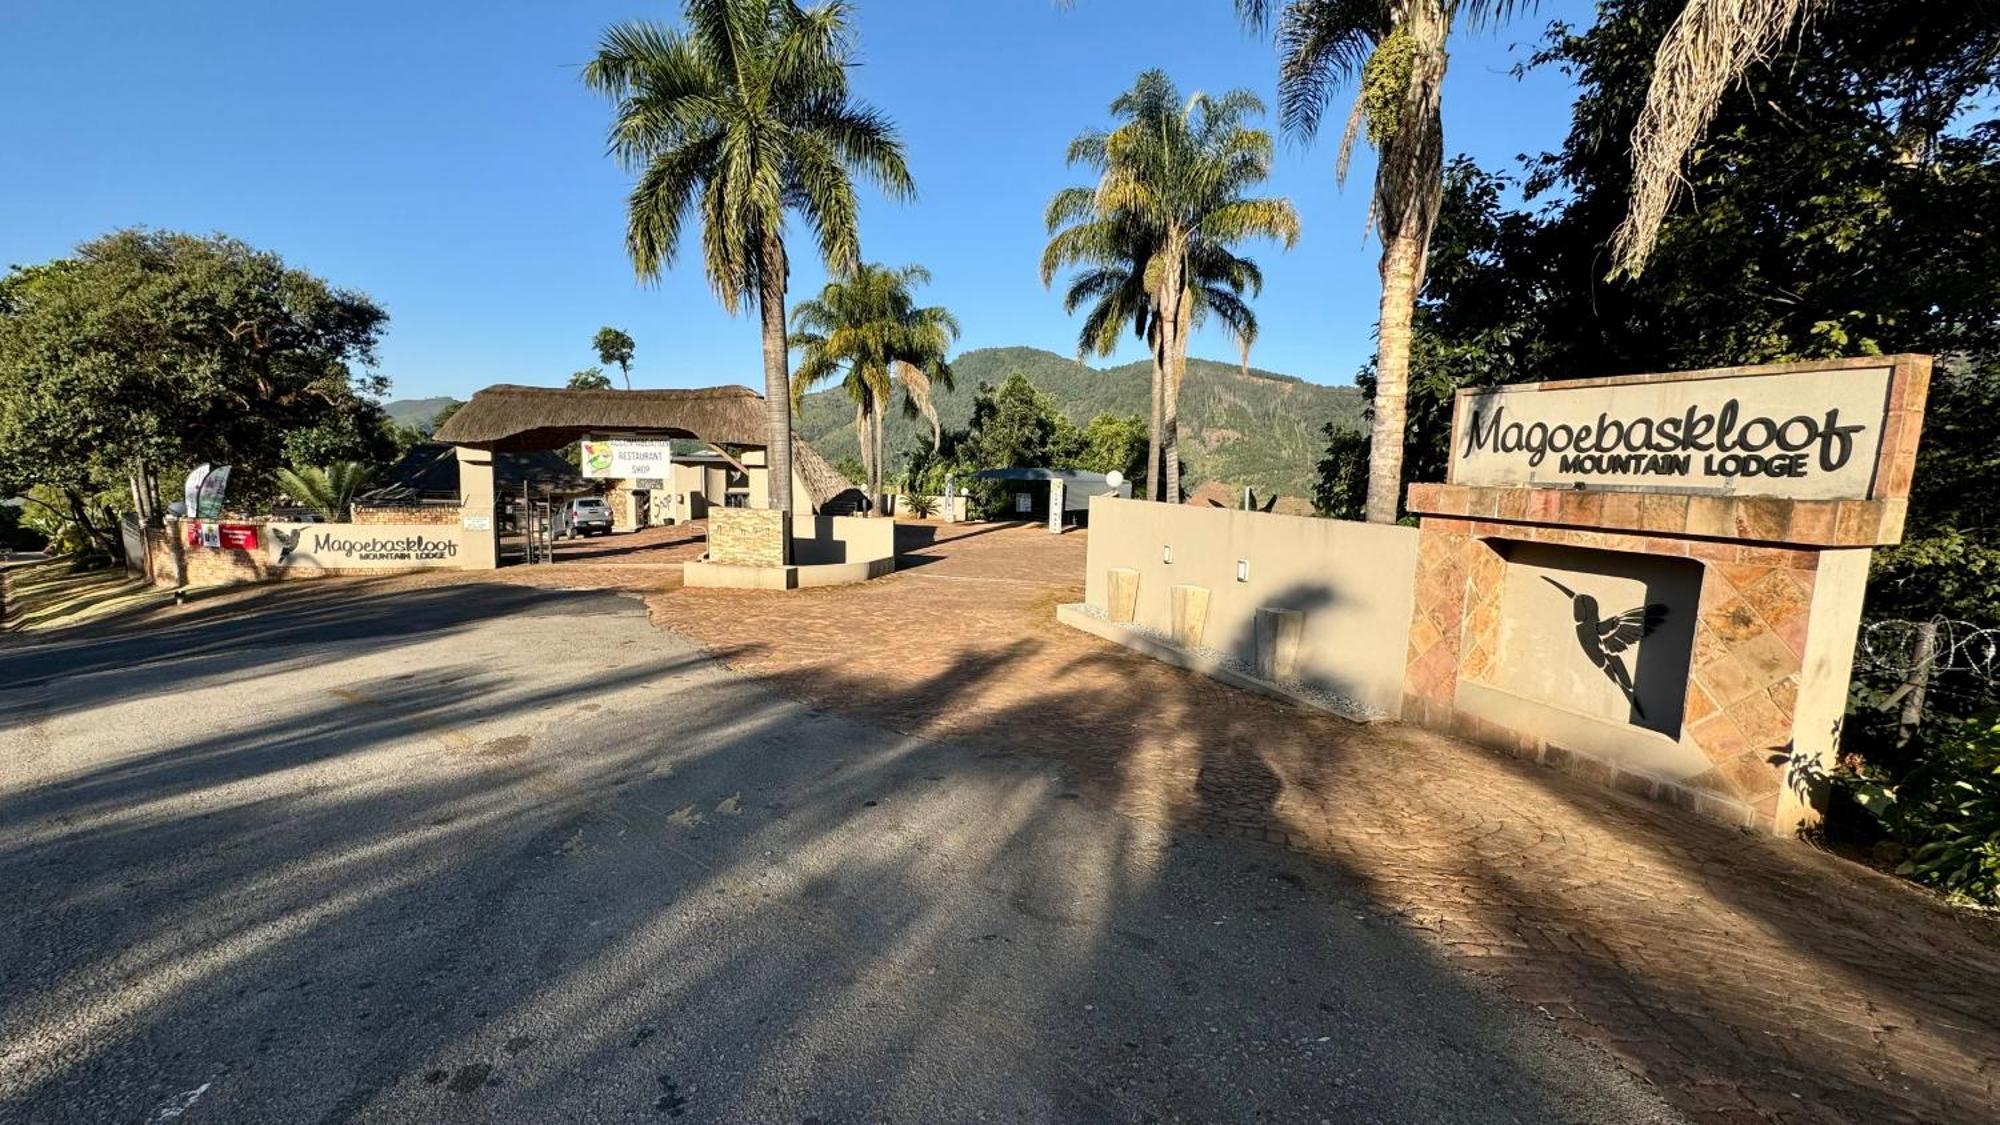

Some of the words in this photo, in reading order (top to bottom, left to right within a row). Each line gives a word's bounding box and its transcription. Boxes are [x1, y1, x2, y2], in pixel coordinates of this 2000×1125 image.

[1462, 398, 1866, 472] Magoebaskloof
[618, 451, 663, 461] RESTAURANT
[632, 465, 651, 474] SHOP
[1559, 453, 1691, 477] MOUNTAIN
[1703, 453, 1810, 478] LODGE
[313, 533, 459, 557] Magoebaskloof
[359, 552, 411, 560] MOUNTAIN
[415, 551, 447, 560] LODGE
